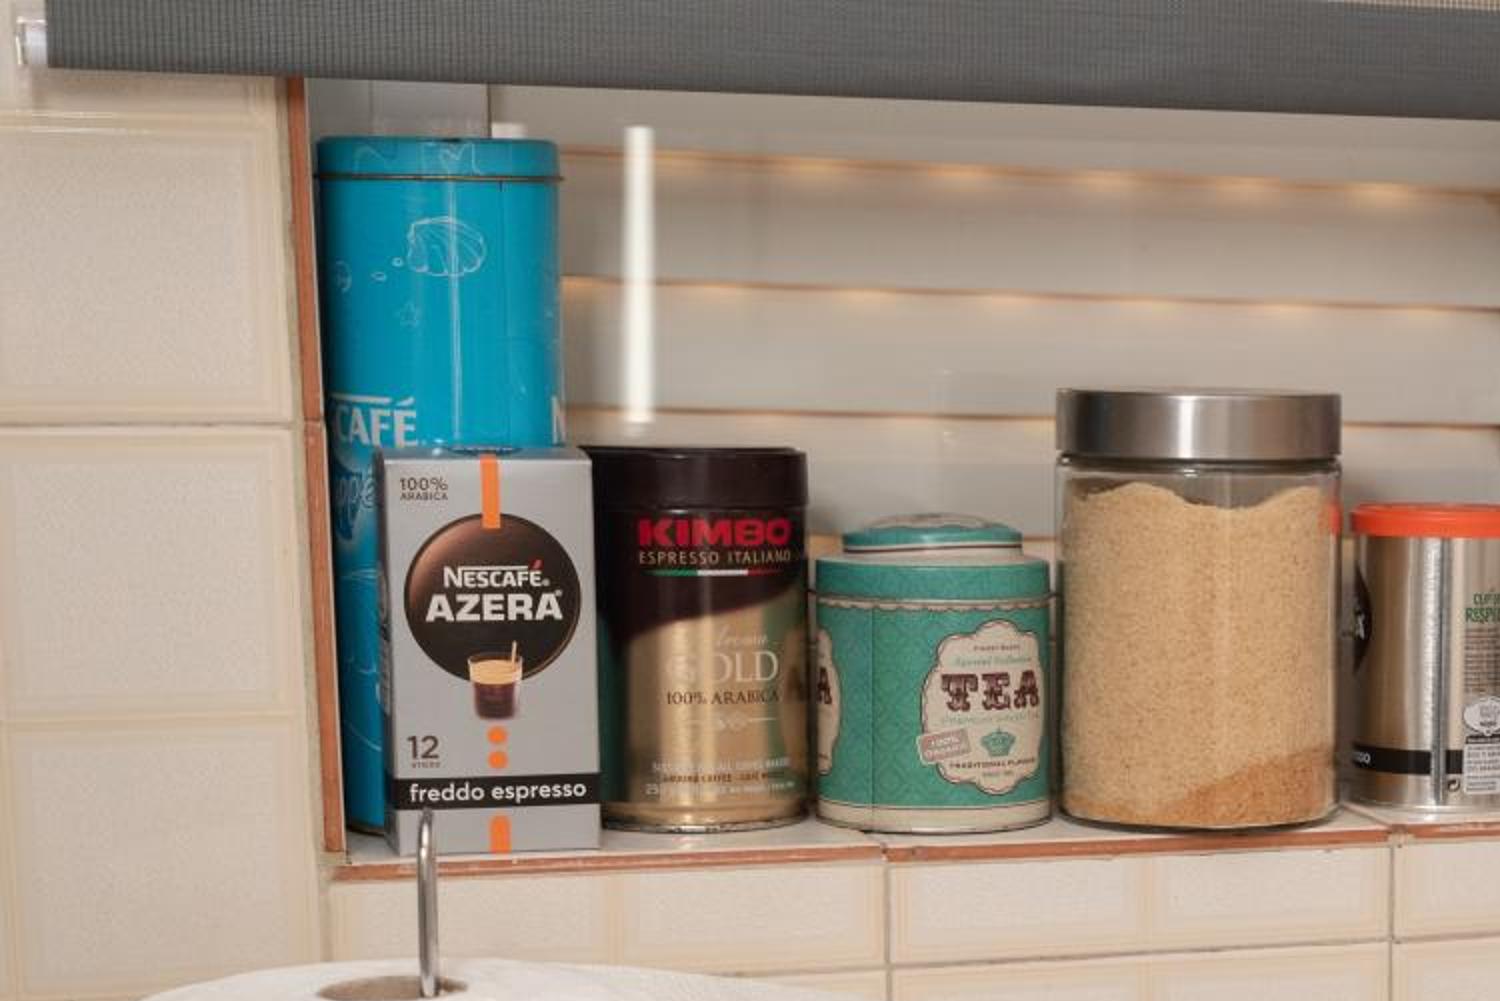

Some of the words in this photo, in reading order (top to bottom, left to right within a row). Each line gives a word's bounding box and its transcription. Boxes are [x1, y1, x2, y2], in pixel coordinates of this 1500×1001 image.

[399, 477, 448, 490] 100%
[399, 491, 449, 501] ARABICA
[638, 517, 791, 546] KIMBO
[638, 551, 719, 565] ESPRESSO
[727, 550, 791, 564] ITALIANO
[443, 559, 544, 588] NESCAFÉ
[425, 592, 564, 622] AZERA
[941, 670, 1040, 712] TEA
[407, 735, 440, 759] 12
[409, 781, 485, 802] freddo
[491, 782, 587, 804] espresso
